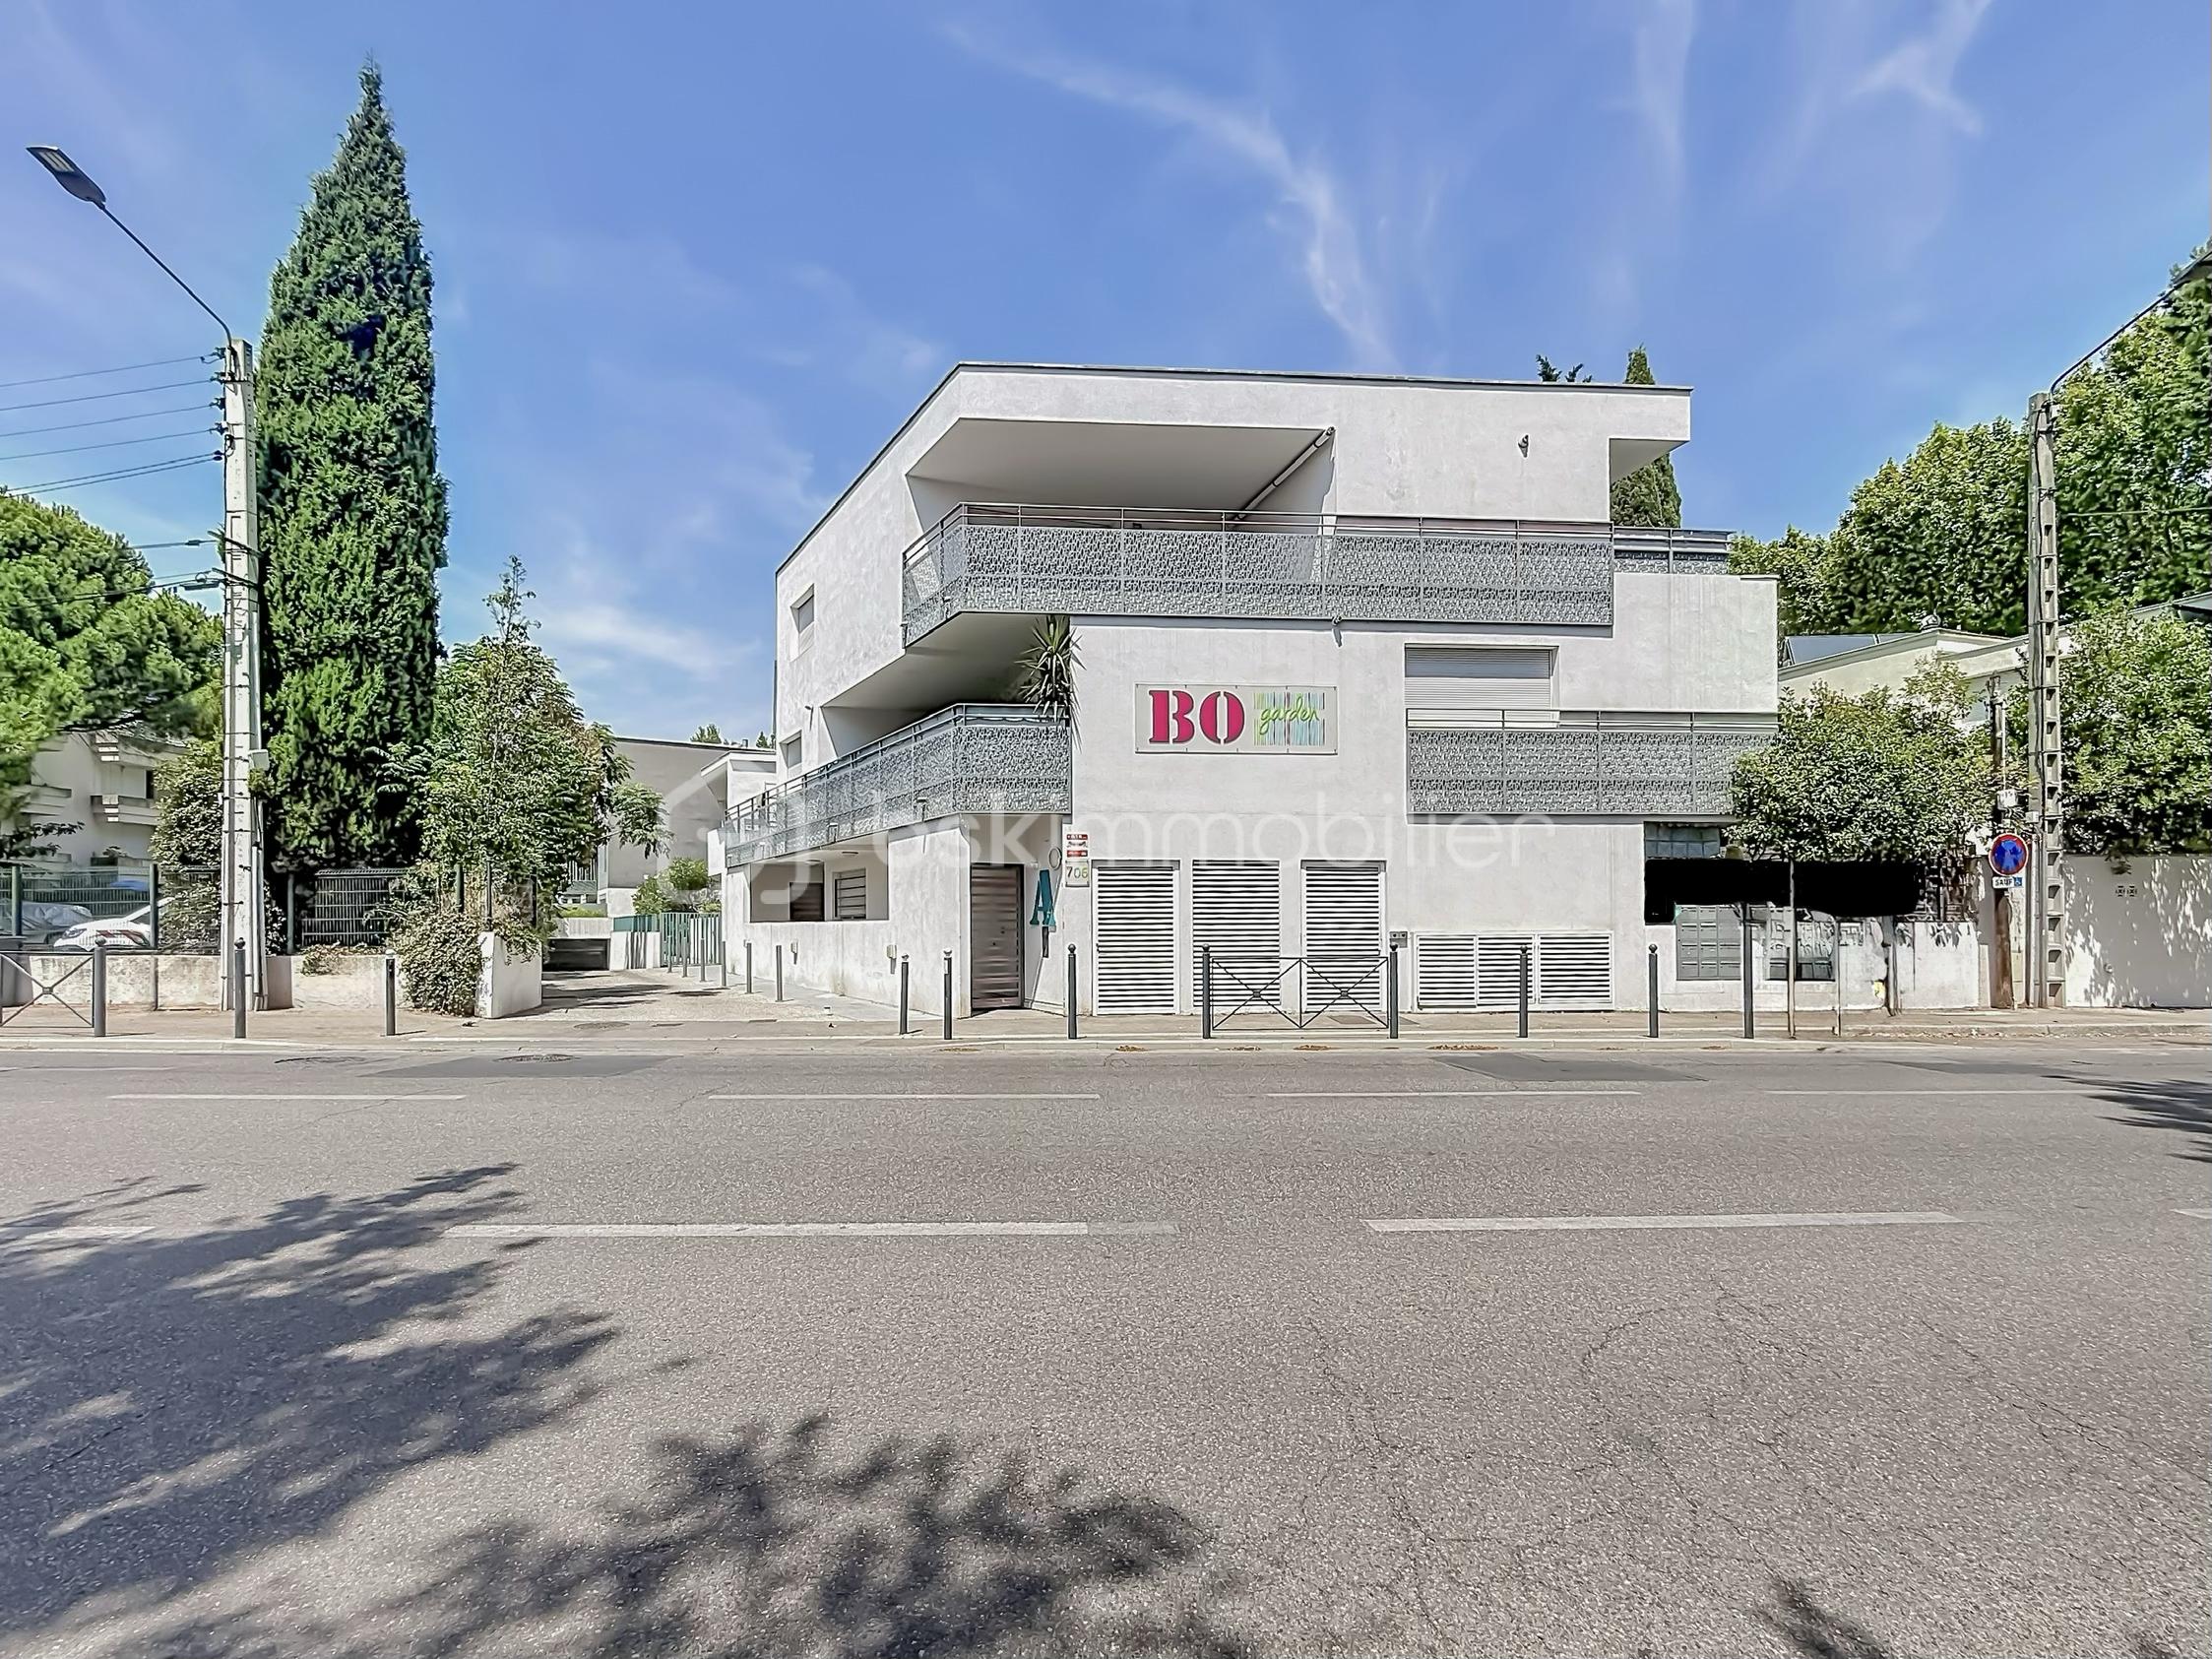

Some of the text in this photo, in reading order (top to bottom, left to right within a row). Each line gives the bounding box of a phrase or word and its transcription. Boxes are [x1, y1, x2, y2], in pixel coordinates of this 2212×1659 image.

[1148, 689, 1320, 744] BO garden
[1030, 869, 1056, 925] A
[1066, 865, 1088, 879] 706
